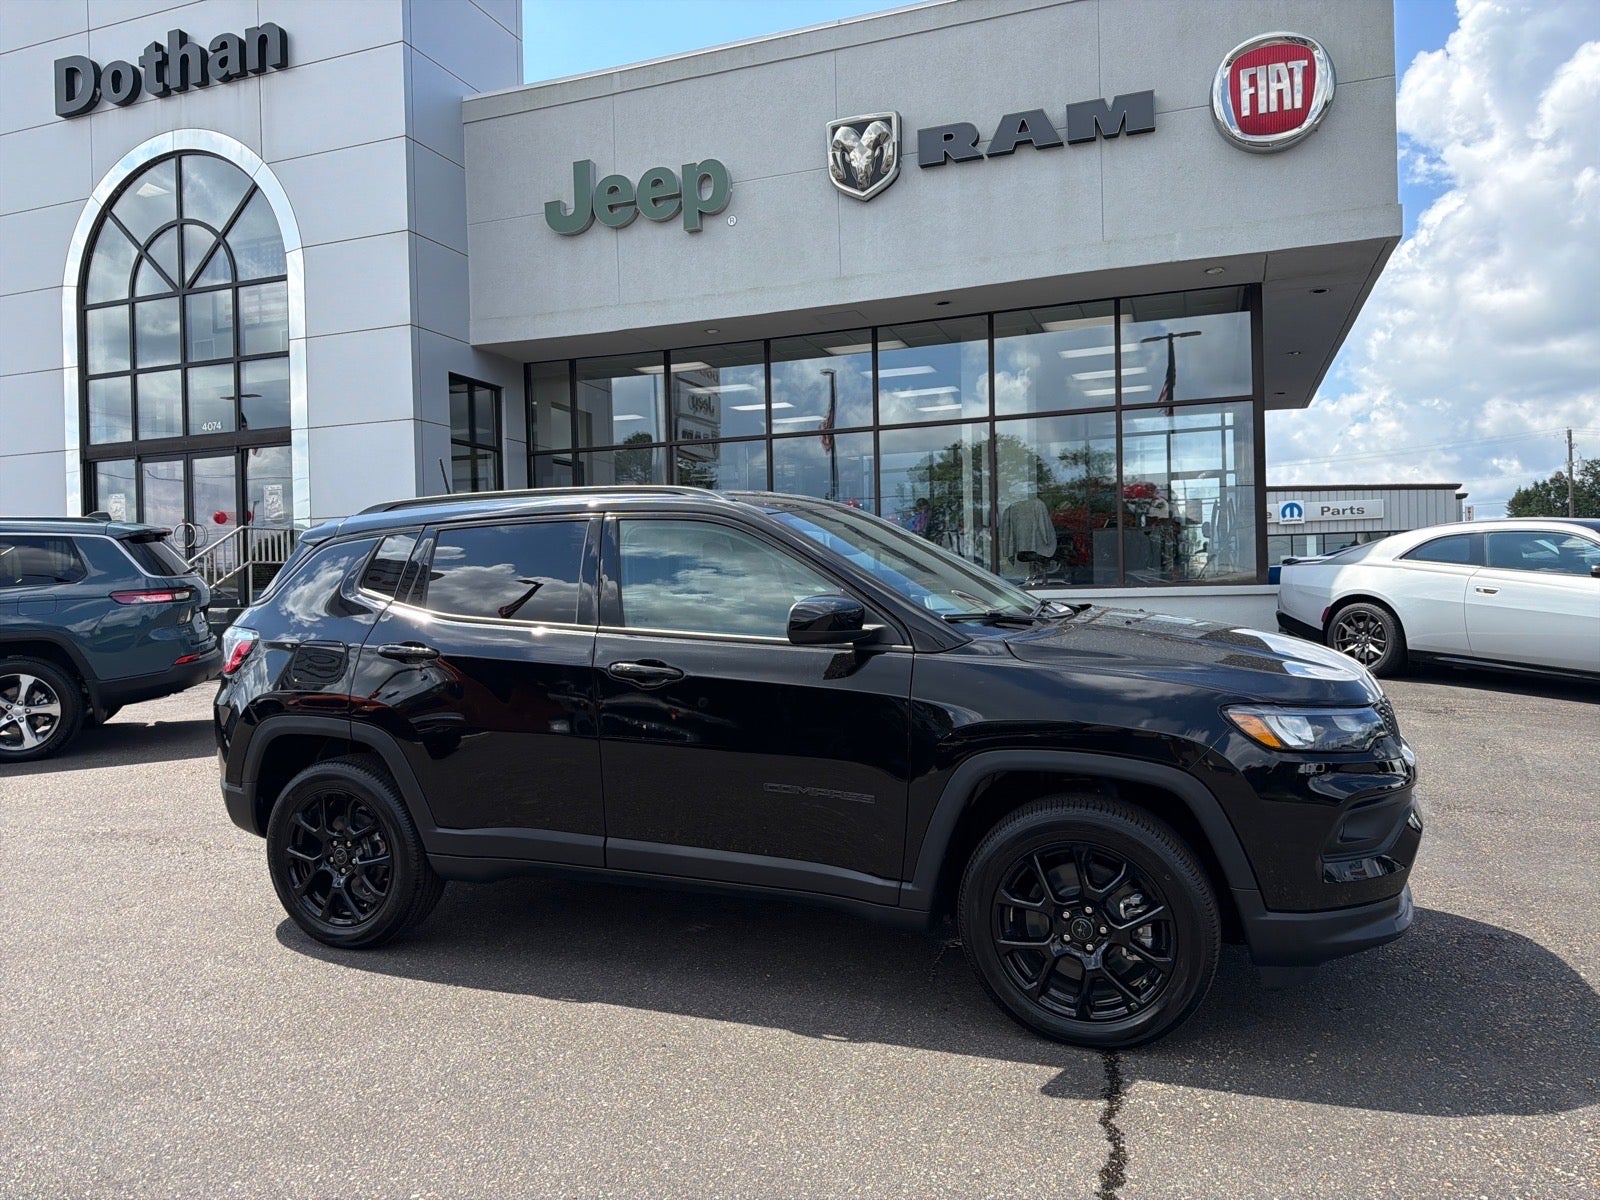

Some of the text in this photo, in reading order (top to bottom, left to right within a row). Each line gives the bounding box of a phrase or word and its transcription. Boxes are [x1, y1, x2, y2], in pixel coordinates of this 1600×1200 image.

[54, 21, 289, 119] Dothan
[1240, 59, 1309, 118] FIAT
[917, 89, 1156, 168] RAM
[544, 158, 733, 236] Jeep
[202, 420, 222, 432] 4074
[1320, 505, 1365, 516] Parts
[763, 782, 876, 805] COMPASS
